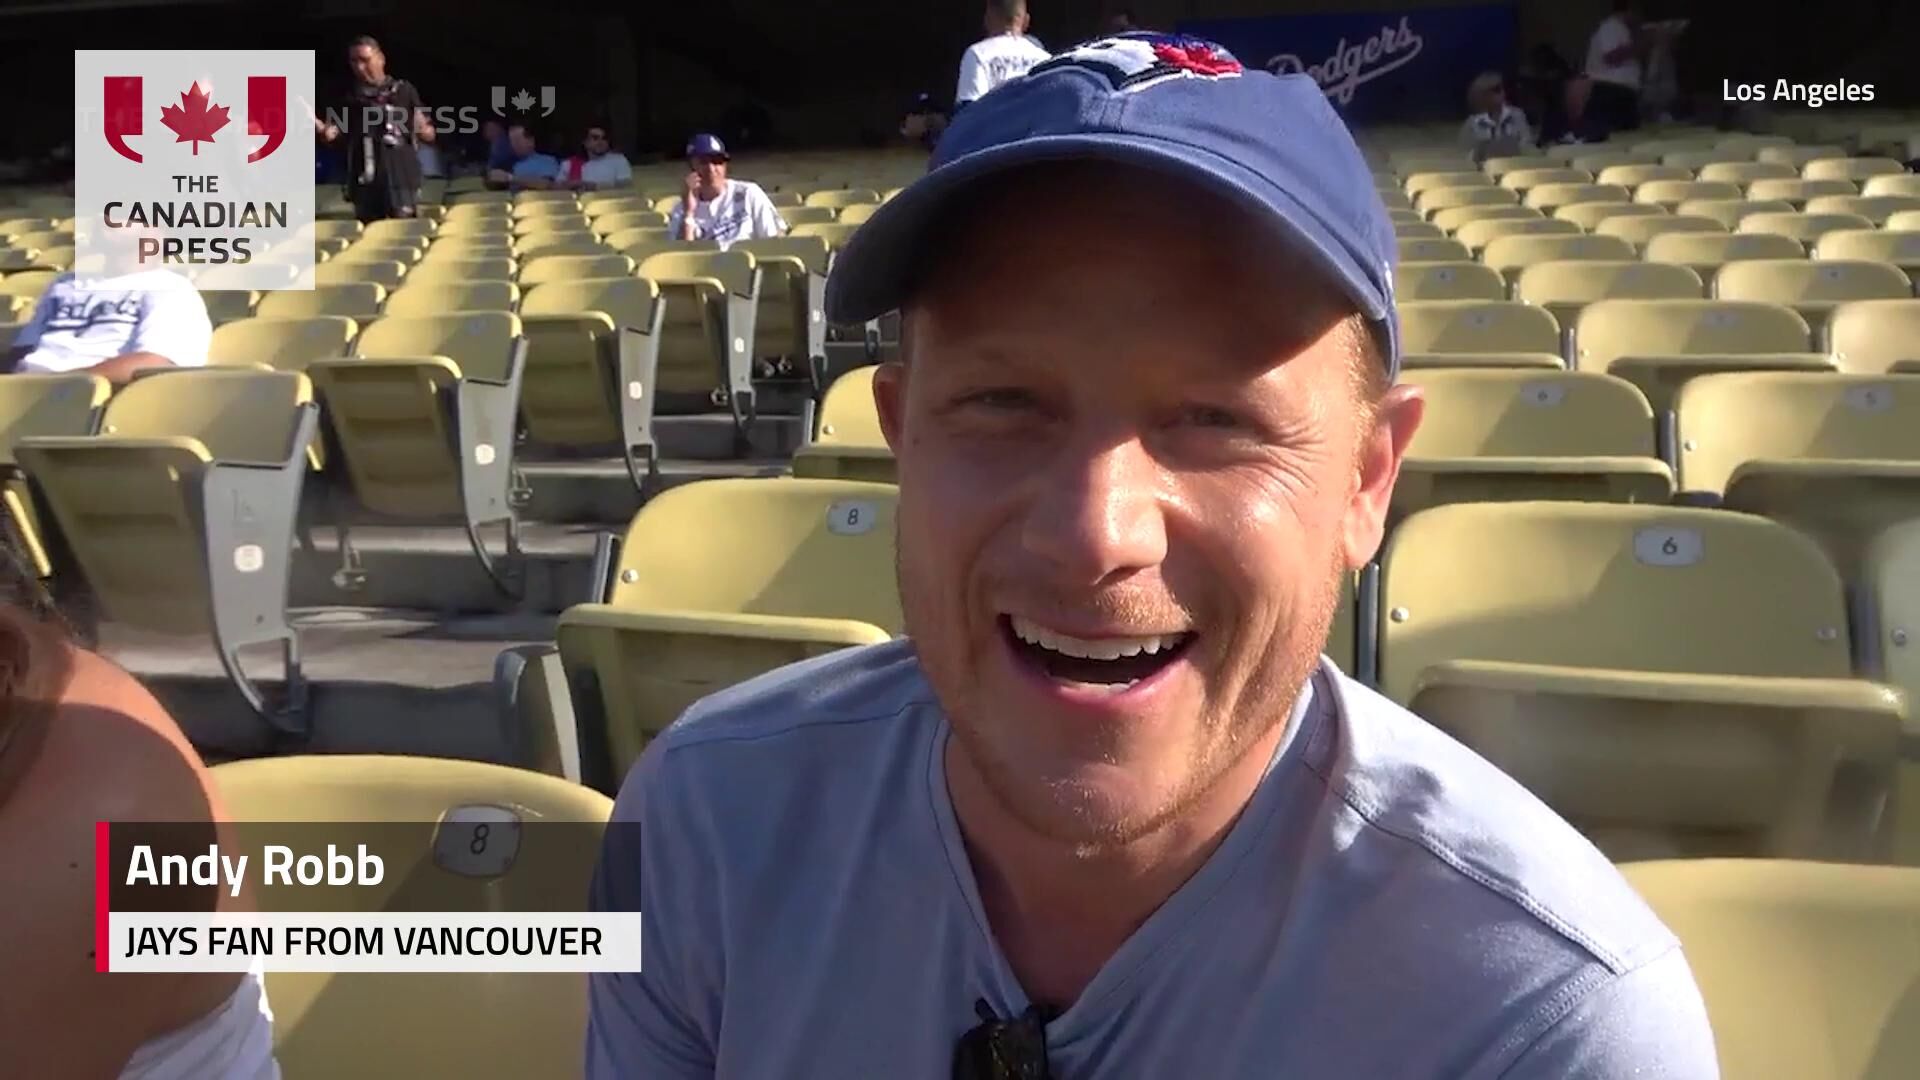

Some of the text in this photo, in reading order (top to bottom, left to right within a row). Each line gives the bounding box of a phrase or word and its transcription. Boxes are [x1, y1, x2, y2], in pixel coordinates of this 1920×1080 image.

[847, 508, 859, 526] 8
[1662, 536, 1678, 556] 6
[470, 823, 490, 856] 8
